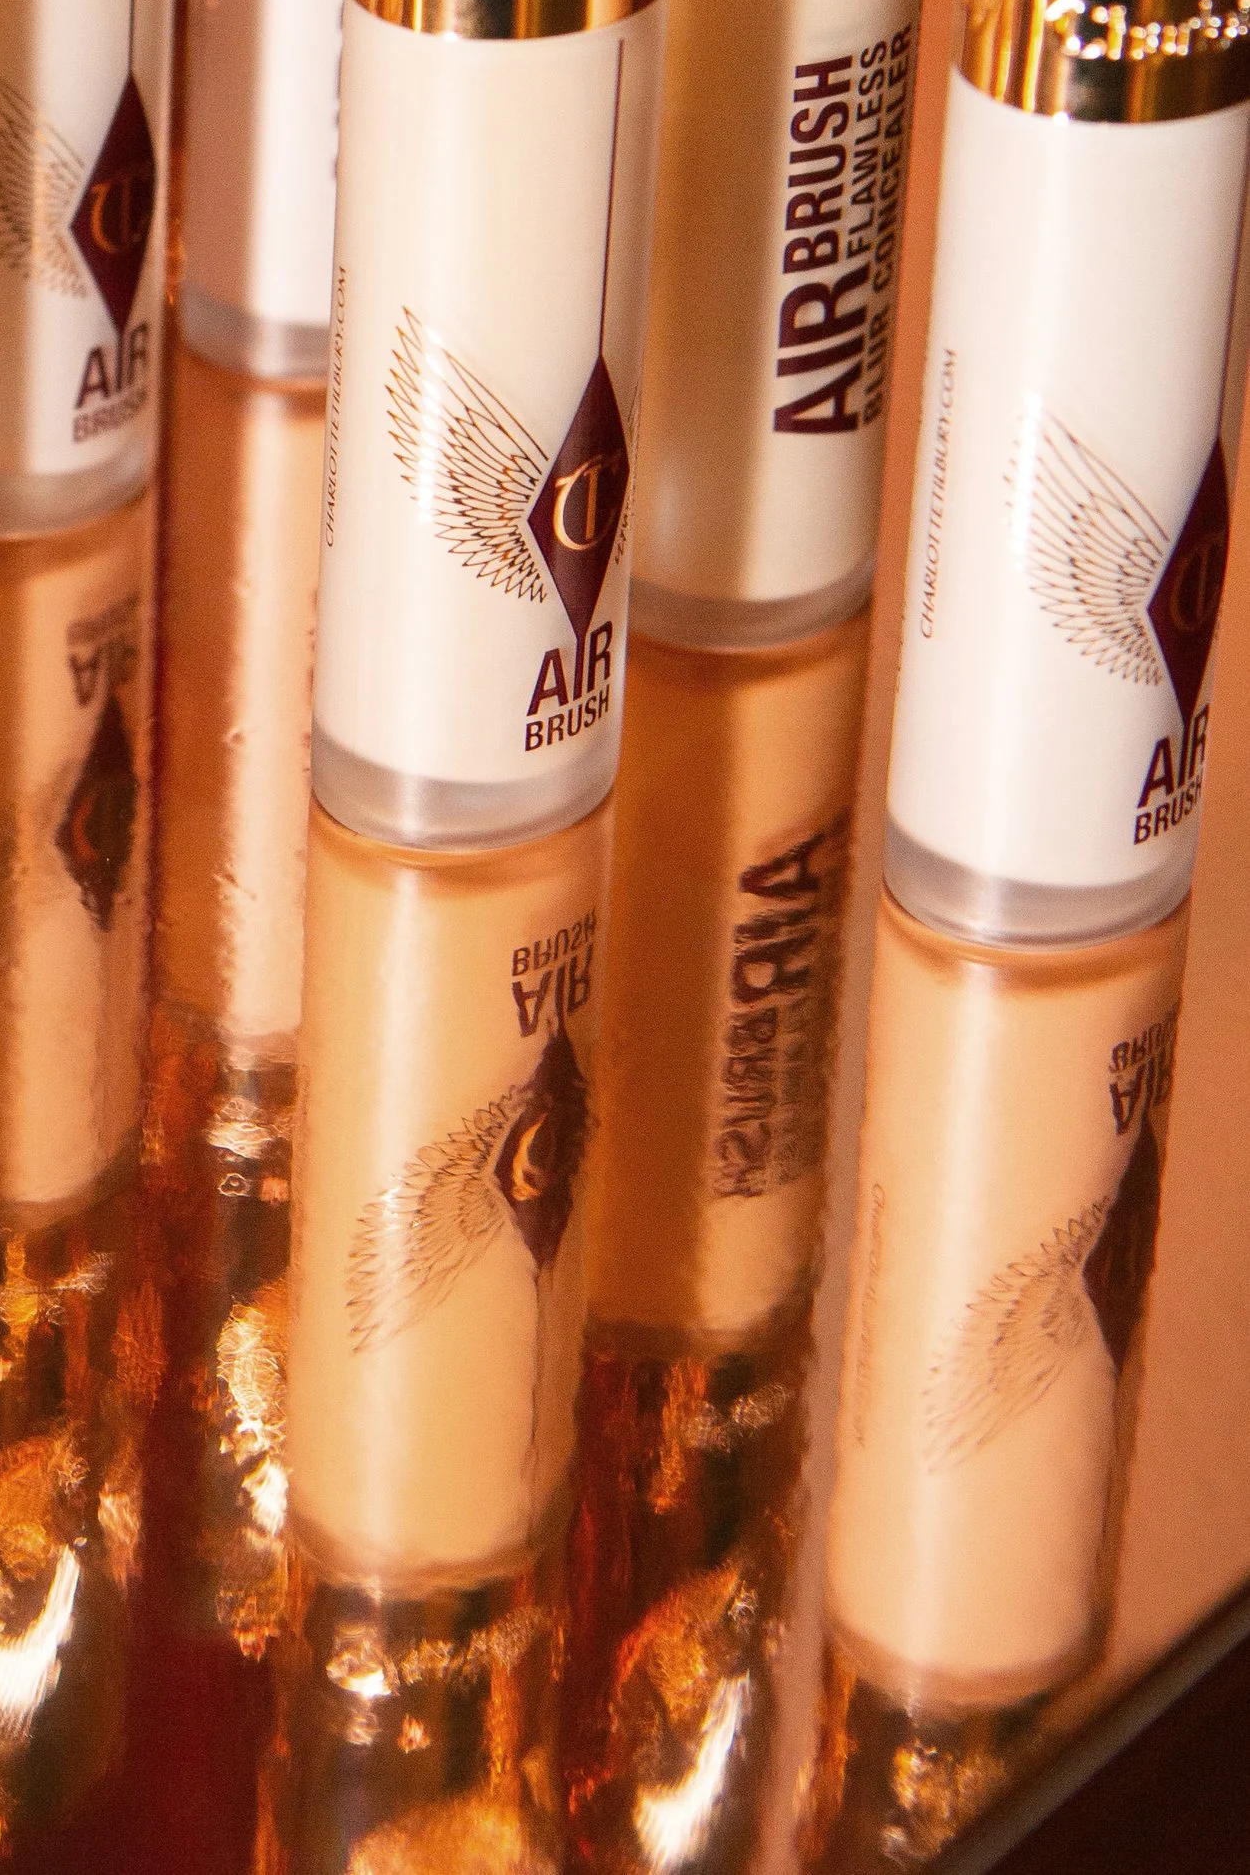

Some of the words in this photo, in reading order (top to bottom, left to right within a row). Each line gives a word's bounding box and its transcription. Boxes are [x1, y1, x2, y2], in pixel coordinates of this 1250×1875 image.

[845, 38, 890, 261] FLAWLESS
[870, 20, 913, 296] CONCEALER
[75, 321, 151, 411] AIR
[324, 264, 348, 549] CHARLOTTETILBURY.COM
[861, 298, 890, 427] BLUR
[920, 347, 957, 640] CHARLOTTETILBURY.COM
[523, 682, 610, 753] BRUSH
[525, 619, 615, 718] AIR
[1136, 700, 1211, 810] AIR
